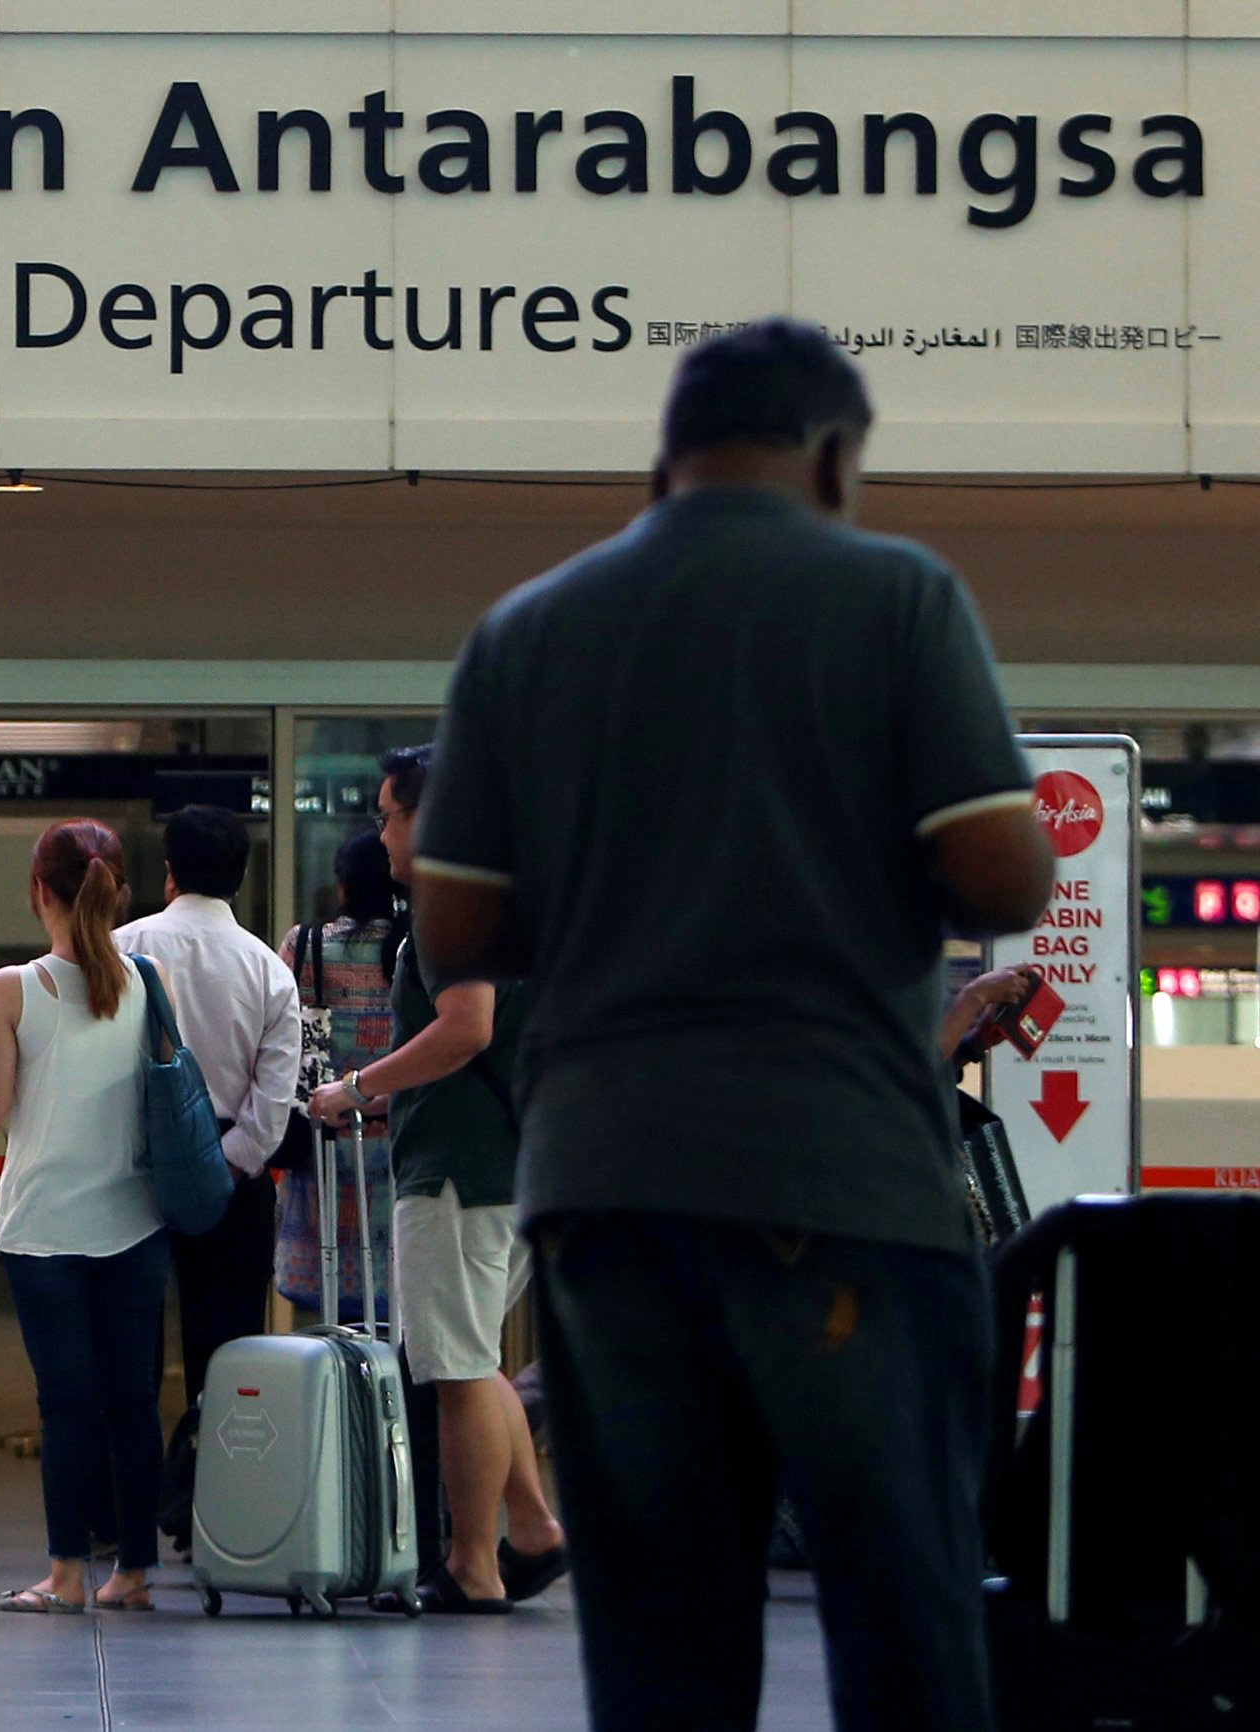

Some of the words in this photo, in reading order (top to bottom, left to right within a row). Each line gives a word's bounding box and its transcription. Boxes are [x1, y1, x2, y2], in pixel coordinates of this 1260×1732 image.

[130, 75, 1205, 232] Antarabangsa
[15, 262, 633, 375] Departures
[1015, 324, 1221, 350] 国際線出発ロビー
[1034, 798, 1097, 830] AirAsia
[1054, 880, 1090, 901] NE
[1039, 908, 1102, 928] ABIN
[1033, 935, 1089, 956] BAG
